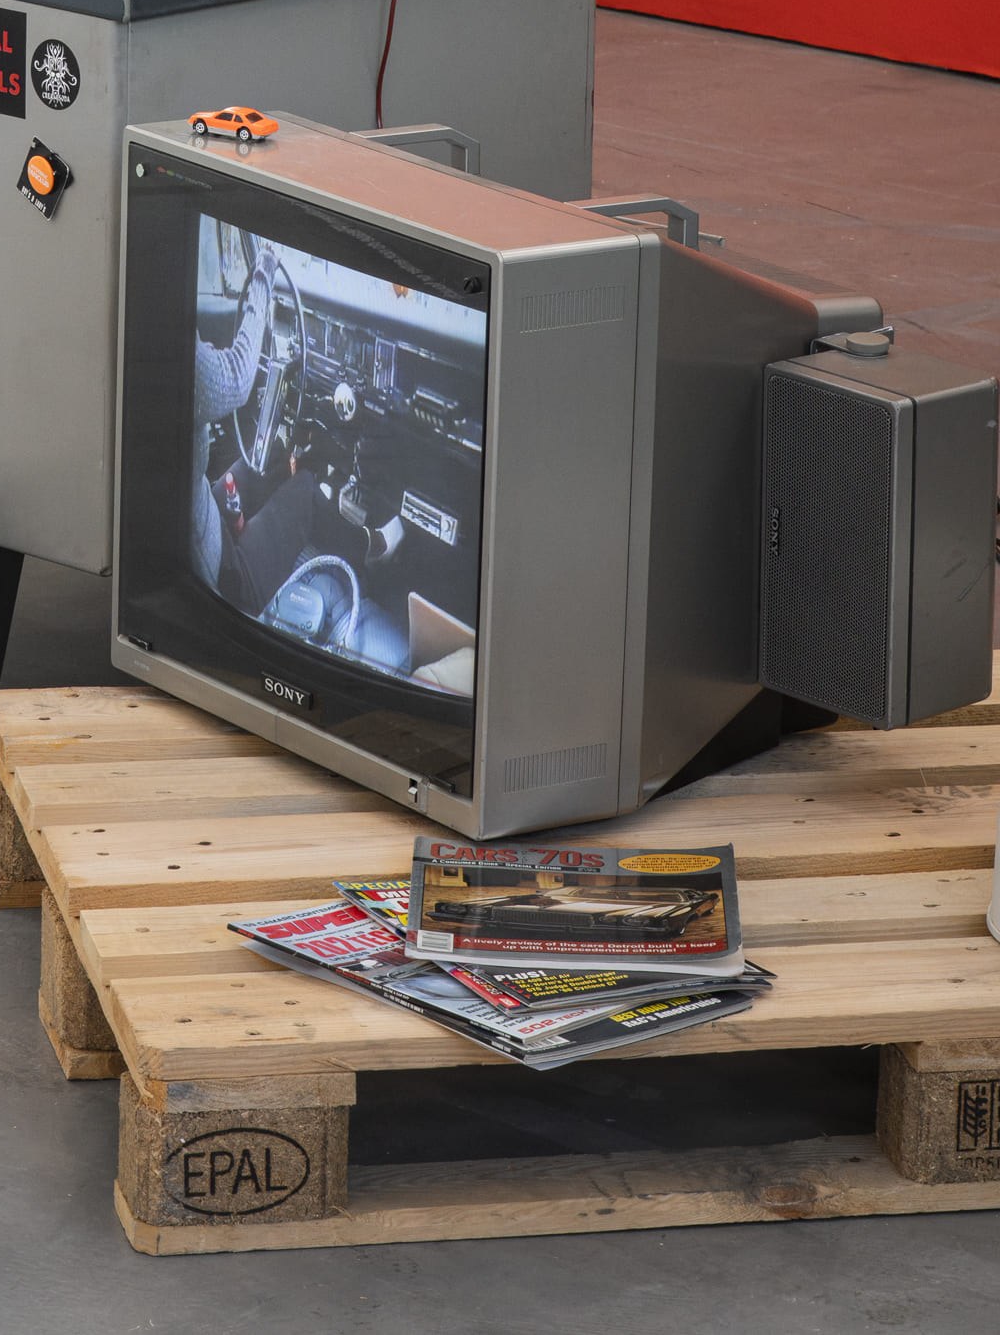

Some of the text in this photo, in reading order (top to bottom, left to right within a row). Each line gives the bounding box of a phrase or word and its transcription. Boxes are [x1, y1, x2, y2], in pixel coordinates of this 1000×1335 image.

[771, 507, 779, 556] SONY
[264, 677, 305, 706] SONY
[430, 842, 518, 863] CARS
[342, 880, 412, 890] SPECIA
[493, 970, 547, 982] PLUS!
[183, 1147, 288, 1198] EPAL
